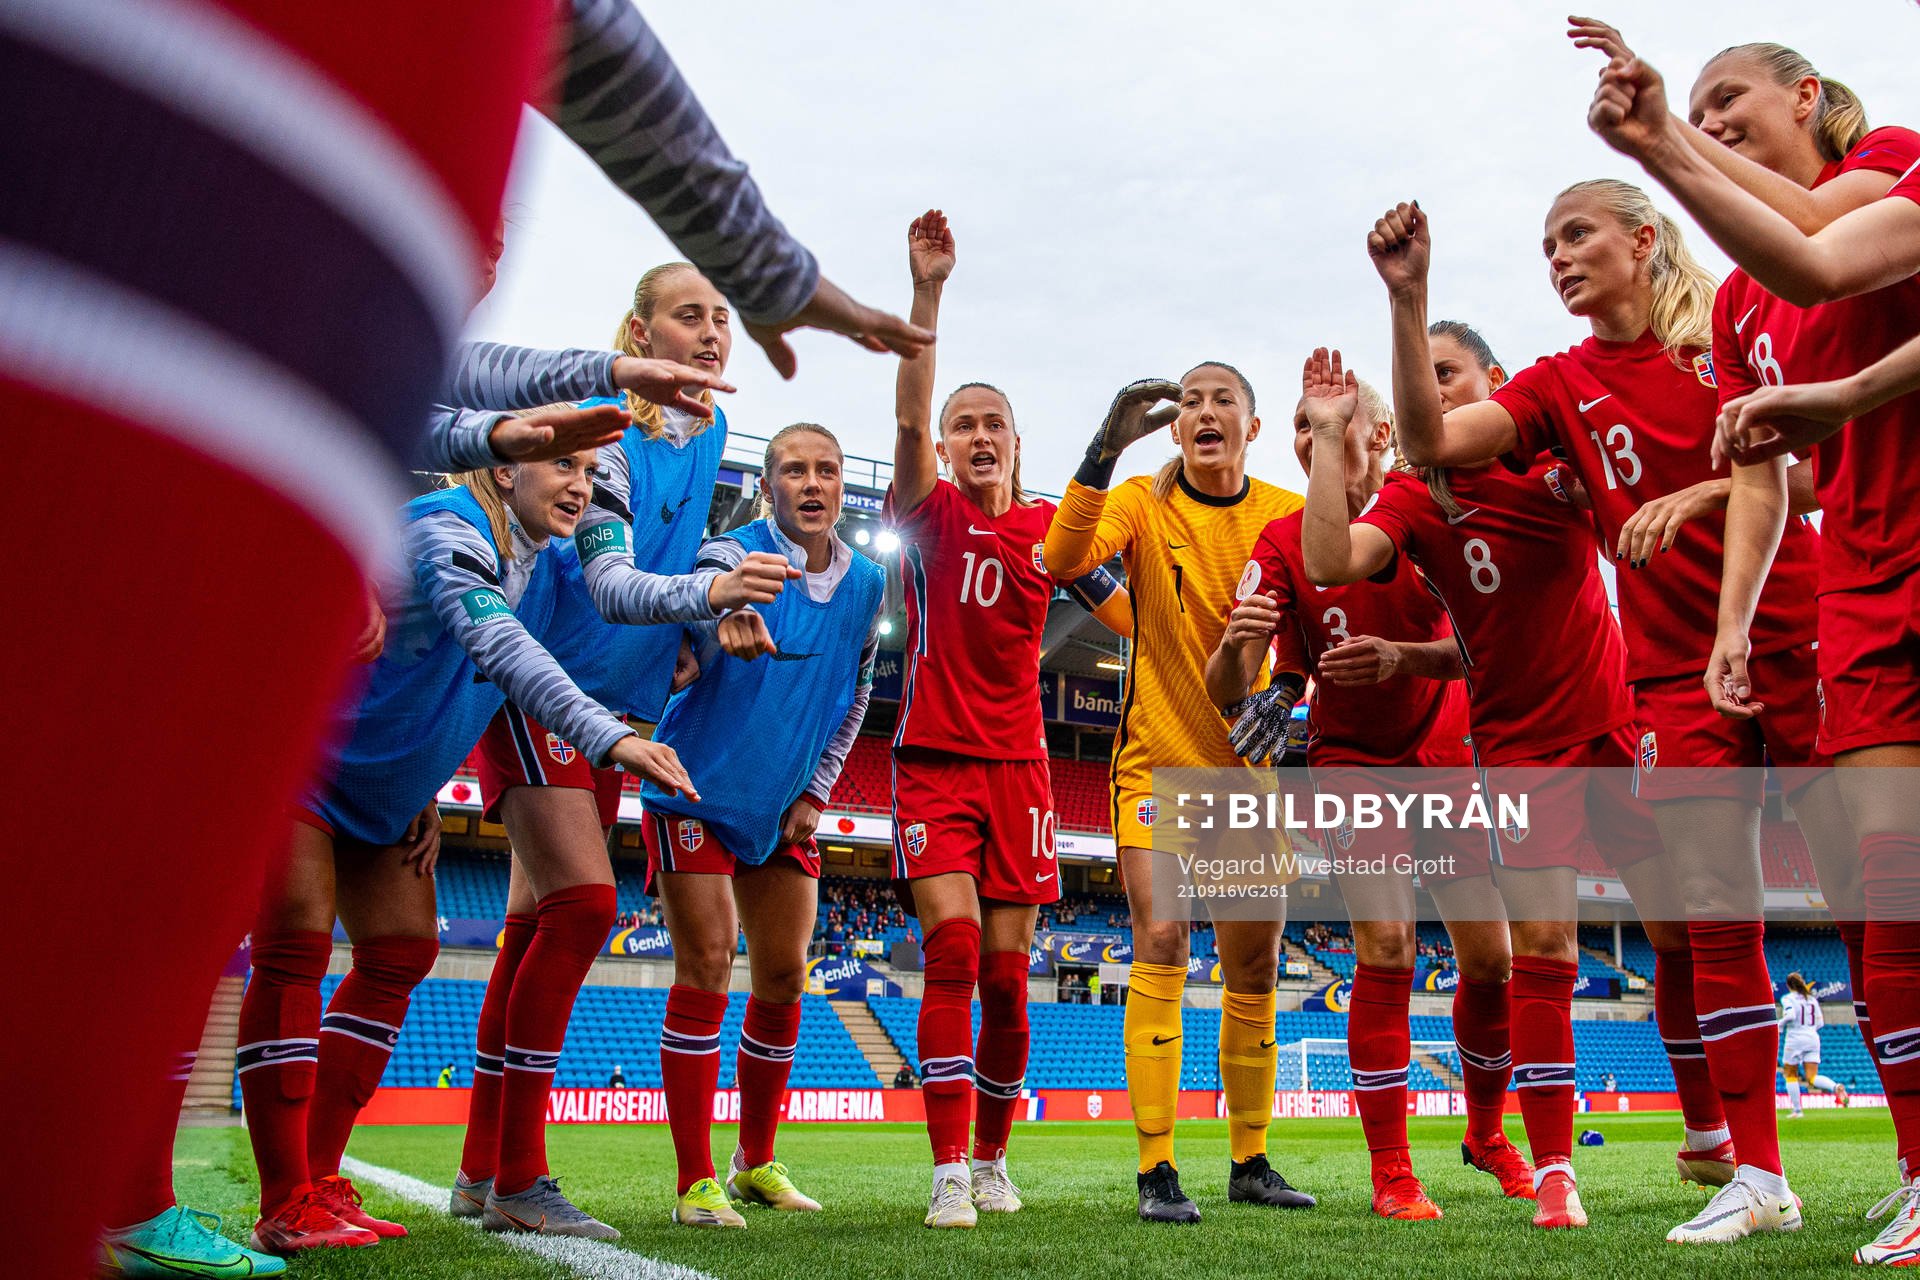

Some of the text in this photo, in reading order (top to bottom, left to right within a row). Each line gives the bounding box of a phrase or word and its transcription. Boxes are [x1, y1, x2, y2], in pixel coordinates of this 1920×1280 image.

[1590, 423, 1643, 490] 13
[583, 526, 615, 550] DNB
[960, 551, 1004, 607] 10
[1463, 538, 1501, 594] 8
[1171, 565, 1185, 613] 1
[1322, 606, 1351, 651] 3
[873, 660, 899, 678] ndit
[1074, 689, 1122, 715] bama
[1029, 807, 1055, 859] 10
[1069, 943, 1091, 956] Bendit
[1110, 945, 1132, 959] Bendit
[815, 958, 863, 983] Bendit
[1800, 1004, 1815, 1026] 13
[545, 1091, 669, 1122] VALIFISERI
[788, 1091, 884, 1121] ARMENIA
[1273, 1093, 1350, 1118] LIFISERING
[1416, 1093, 1468, 1117] ARMEN
